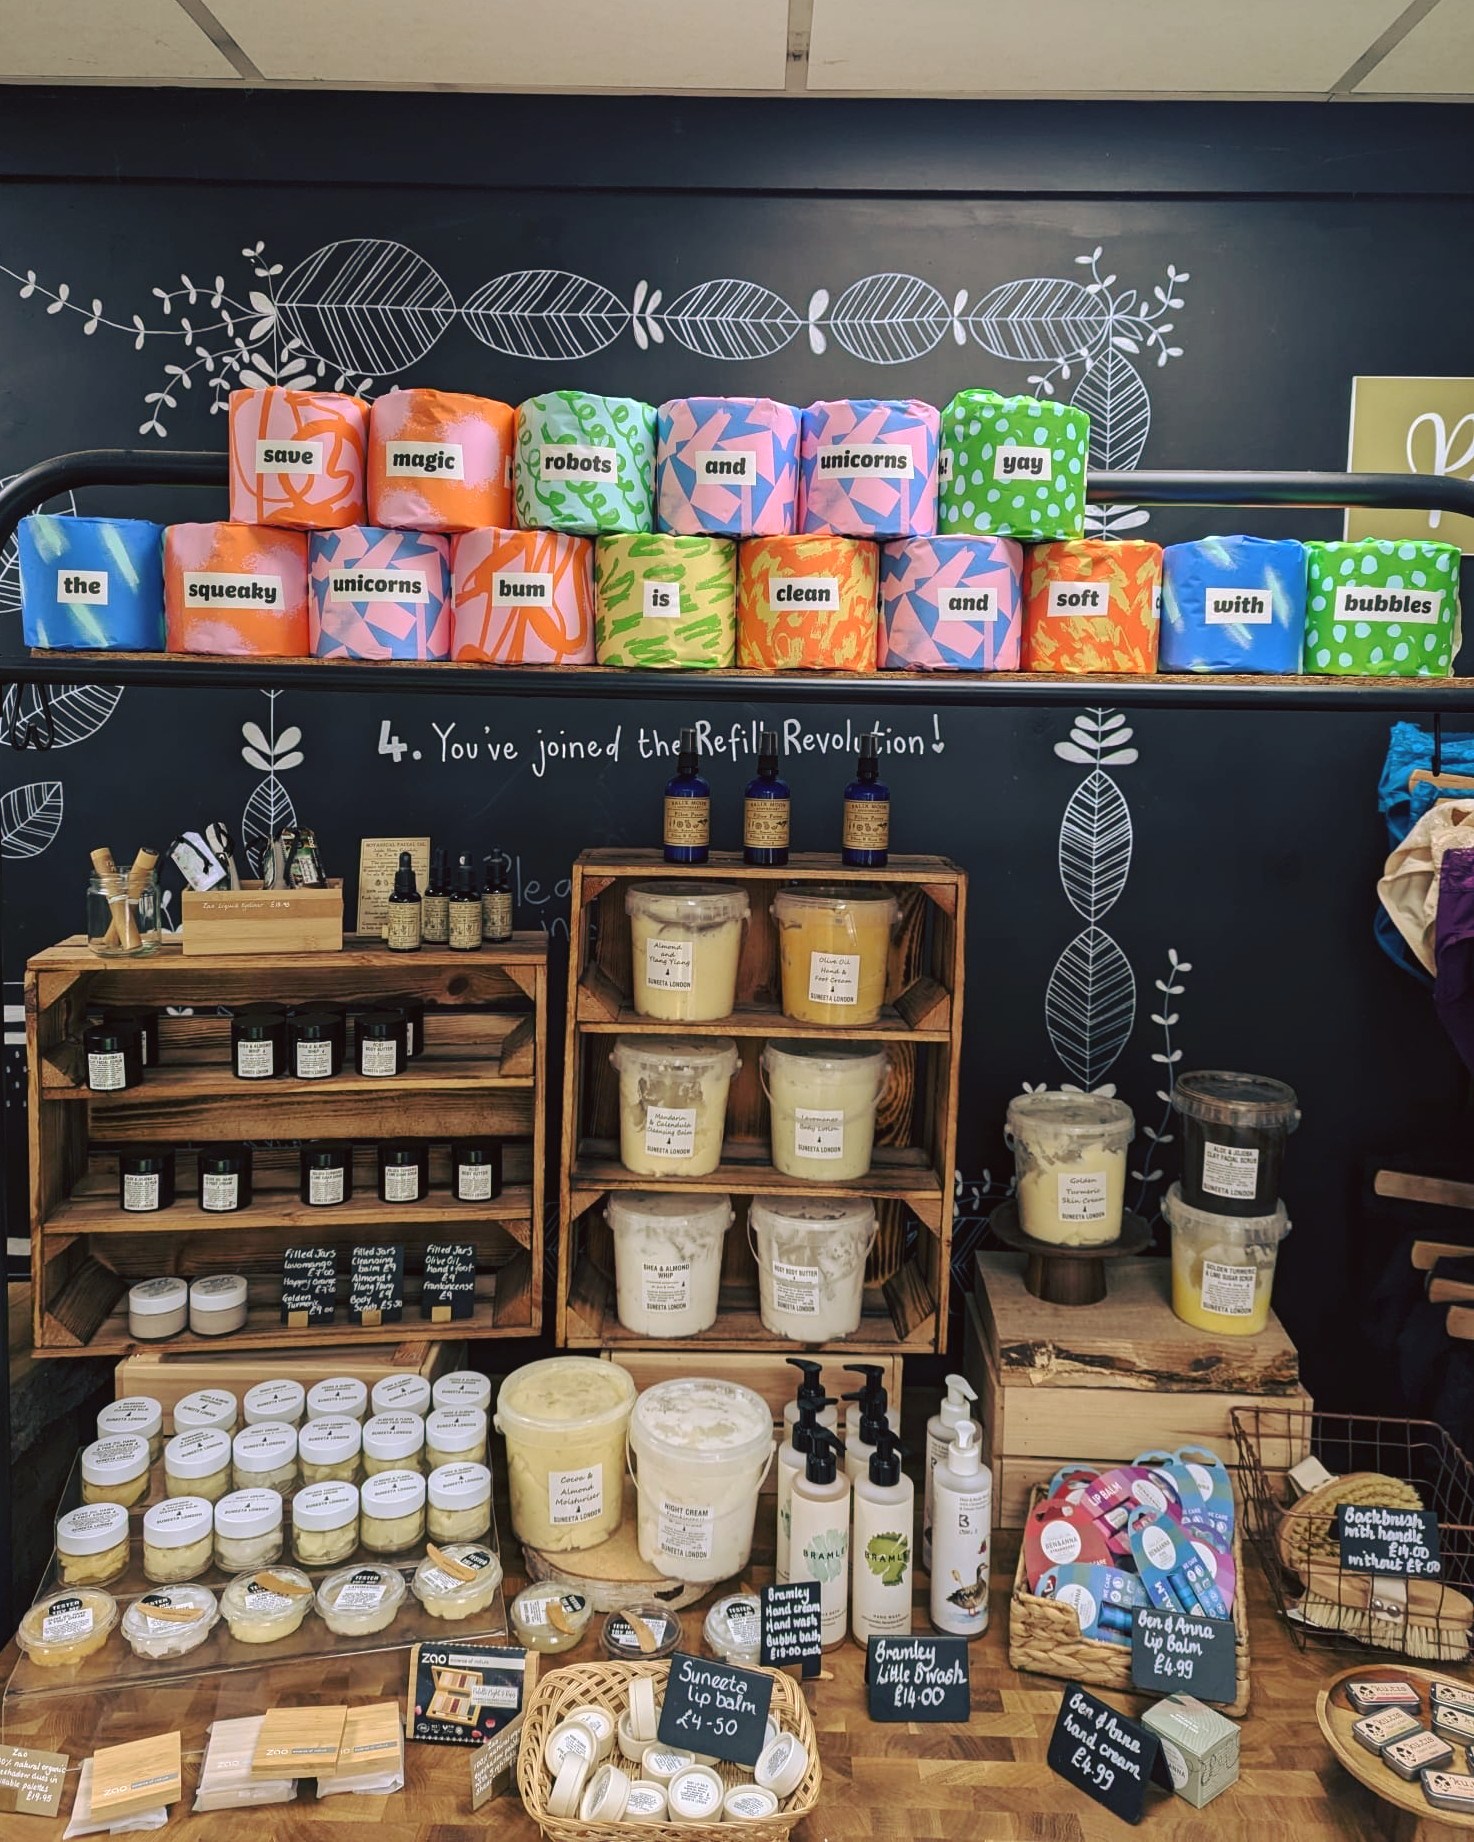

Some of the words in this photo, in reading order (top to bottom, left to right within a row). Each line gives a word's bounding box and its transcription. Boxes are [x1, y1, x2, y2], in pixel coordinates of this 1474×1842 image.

[264, 447, 314, 466] save
[393, 451, 455, 475] magic
[545, 452, 611, 475] robots
[705, 456, 745, 476] and
[820, 450, 907, 470] unicorns
[1003, 452, 1043, 476] yay
[63, 575, 100, 594] the
[189, 580, 277, 608] squeaky
[333, 575, 422, 594] unicorns
[499, 579, 545, 598] bum
[776, 583, 831, 602] clean
[652, 588, 670, 608] is
[949, 593, 989, 612] and
[1056, 588, 1099, 607] soft
[1213, 596, 1264, 615] with
[1345, 594, 1432, 615] bubbles
[377, 720, 422, 763] 4.
[431, 722, 519, 763] You've
[532, 725, 622, 777] joined
[1204, 1184, 1228, 1194] SUNEETA
[1230, 1188, 1254, 1197] LONDON
[285, 1250, 313, 1259] Filled
[314, 1250, 336, 1259] Jars
[353, 1247, 374, 1256] Filled
[376, 1246, 396, 1256] Jars
[426, 1244, 450, 1254] Filled
[452, 1245, 472, 1256] Jars
[425, 1256, 446, 1264] Olive
[643, 1264, 658, 1272] SHEA
[665, 1264, 690, 1272] ALMOND
[1206, 1264, 1227, 1272] GOLDEN
[351, 1274, 382, 1282] Almond
[658, 1272, 674, 1280] WHIP
[354, 1282, 375, 1295] Ylang
[423, 1282, 474, 1290] Frankincense
[282, 1294, 312, 1302] Golden
[1203, 1302, 1228, 1310] SUNEETA
[1230, 1306, 1252, 1314] LONDON
[560, 1476, 585, 1484] Cocoa
[587, 1472, 594, 1480] &
[560, 1485, 594, 1496] Almond
[1088, 1495, 1101, 1507] LIP
[1100, 1482, 1122, 1500] BALM
[554, 1514, 579, 1523] SUNEETA
[580, 1508, 601, 1519] LONDON
[685, 1508, 709, 1517] CREAM
[1344, 1506, 1426, 1530] Backbrush
[1344, 1522, 1376, 1540] with
[1378, 1526, 1424, 1544] handle
[661, 1544, 684, 1557] SUNEETA
[685, 1550, 708, 1559] LONDON
[1348, 1550, 1402, 1572] without
[768, 1587, 810, 1604] Bramley
[766, 1602, 791, 1617] Hand
[794, 1601, 820, 1614] cream
[792, 1614, 818, 1628] wash
[1138, 1610, 1163, 1630] Ben
[1176, 1616, 1216, 1640] Anna
[766, 1632, 798, 1648] Bubble
[799, 1629, 821, 1644] bath
[1144, 1634, 1163, 1655] Lip
[1167, 1636, 1204, 1656] Balm
[421, 1652, 446, 1664] zao
[875, 1640, 936, 1669] Bramley
[678, 1661, 748, 1693] Suneeta
[876, 1663, 910, 1685] Little
[1154, 1657, 1193, 1679] £4.99
[687, 1684, 712, 1707] lip
[715, 1690, 757, 1716] balm
[894, 1686, 945, 1710] £14.00
[1069, 1693, 1094, 1720] Ben
[1106, 1718, 1142, 1754] Anna
[12, 1748, 28, 1758] Zao
[1063, 1714, 1096, 1750] hand
[1099, 1743, 1142, 1780] cream
[14, 1760, 41, 1771] natural
[42, 1764, 66, 1776] organic
[1070, 1748, 1115, 1791] £4.99
[22, 1784, 49, 1794] palettes
[26, 1792, 54, 1802] £19.95
